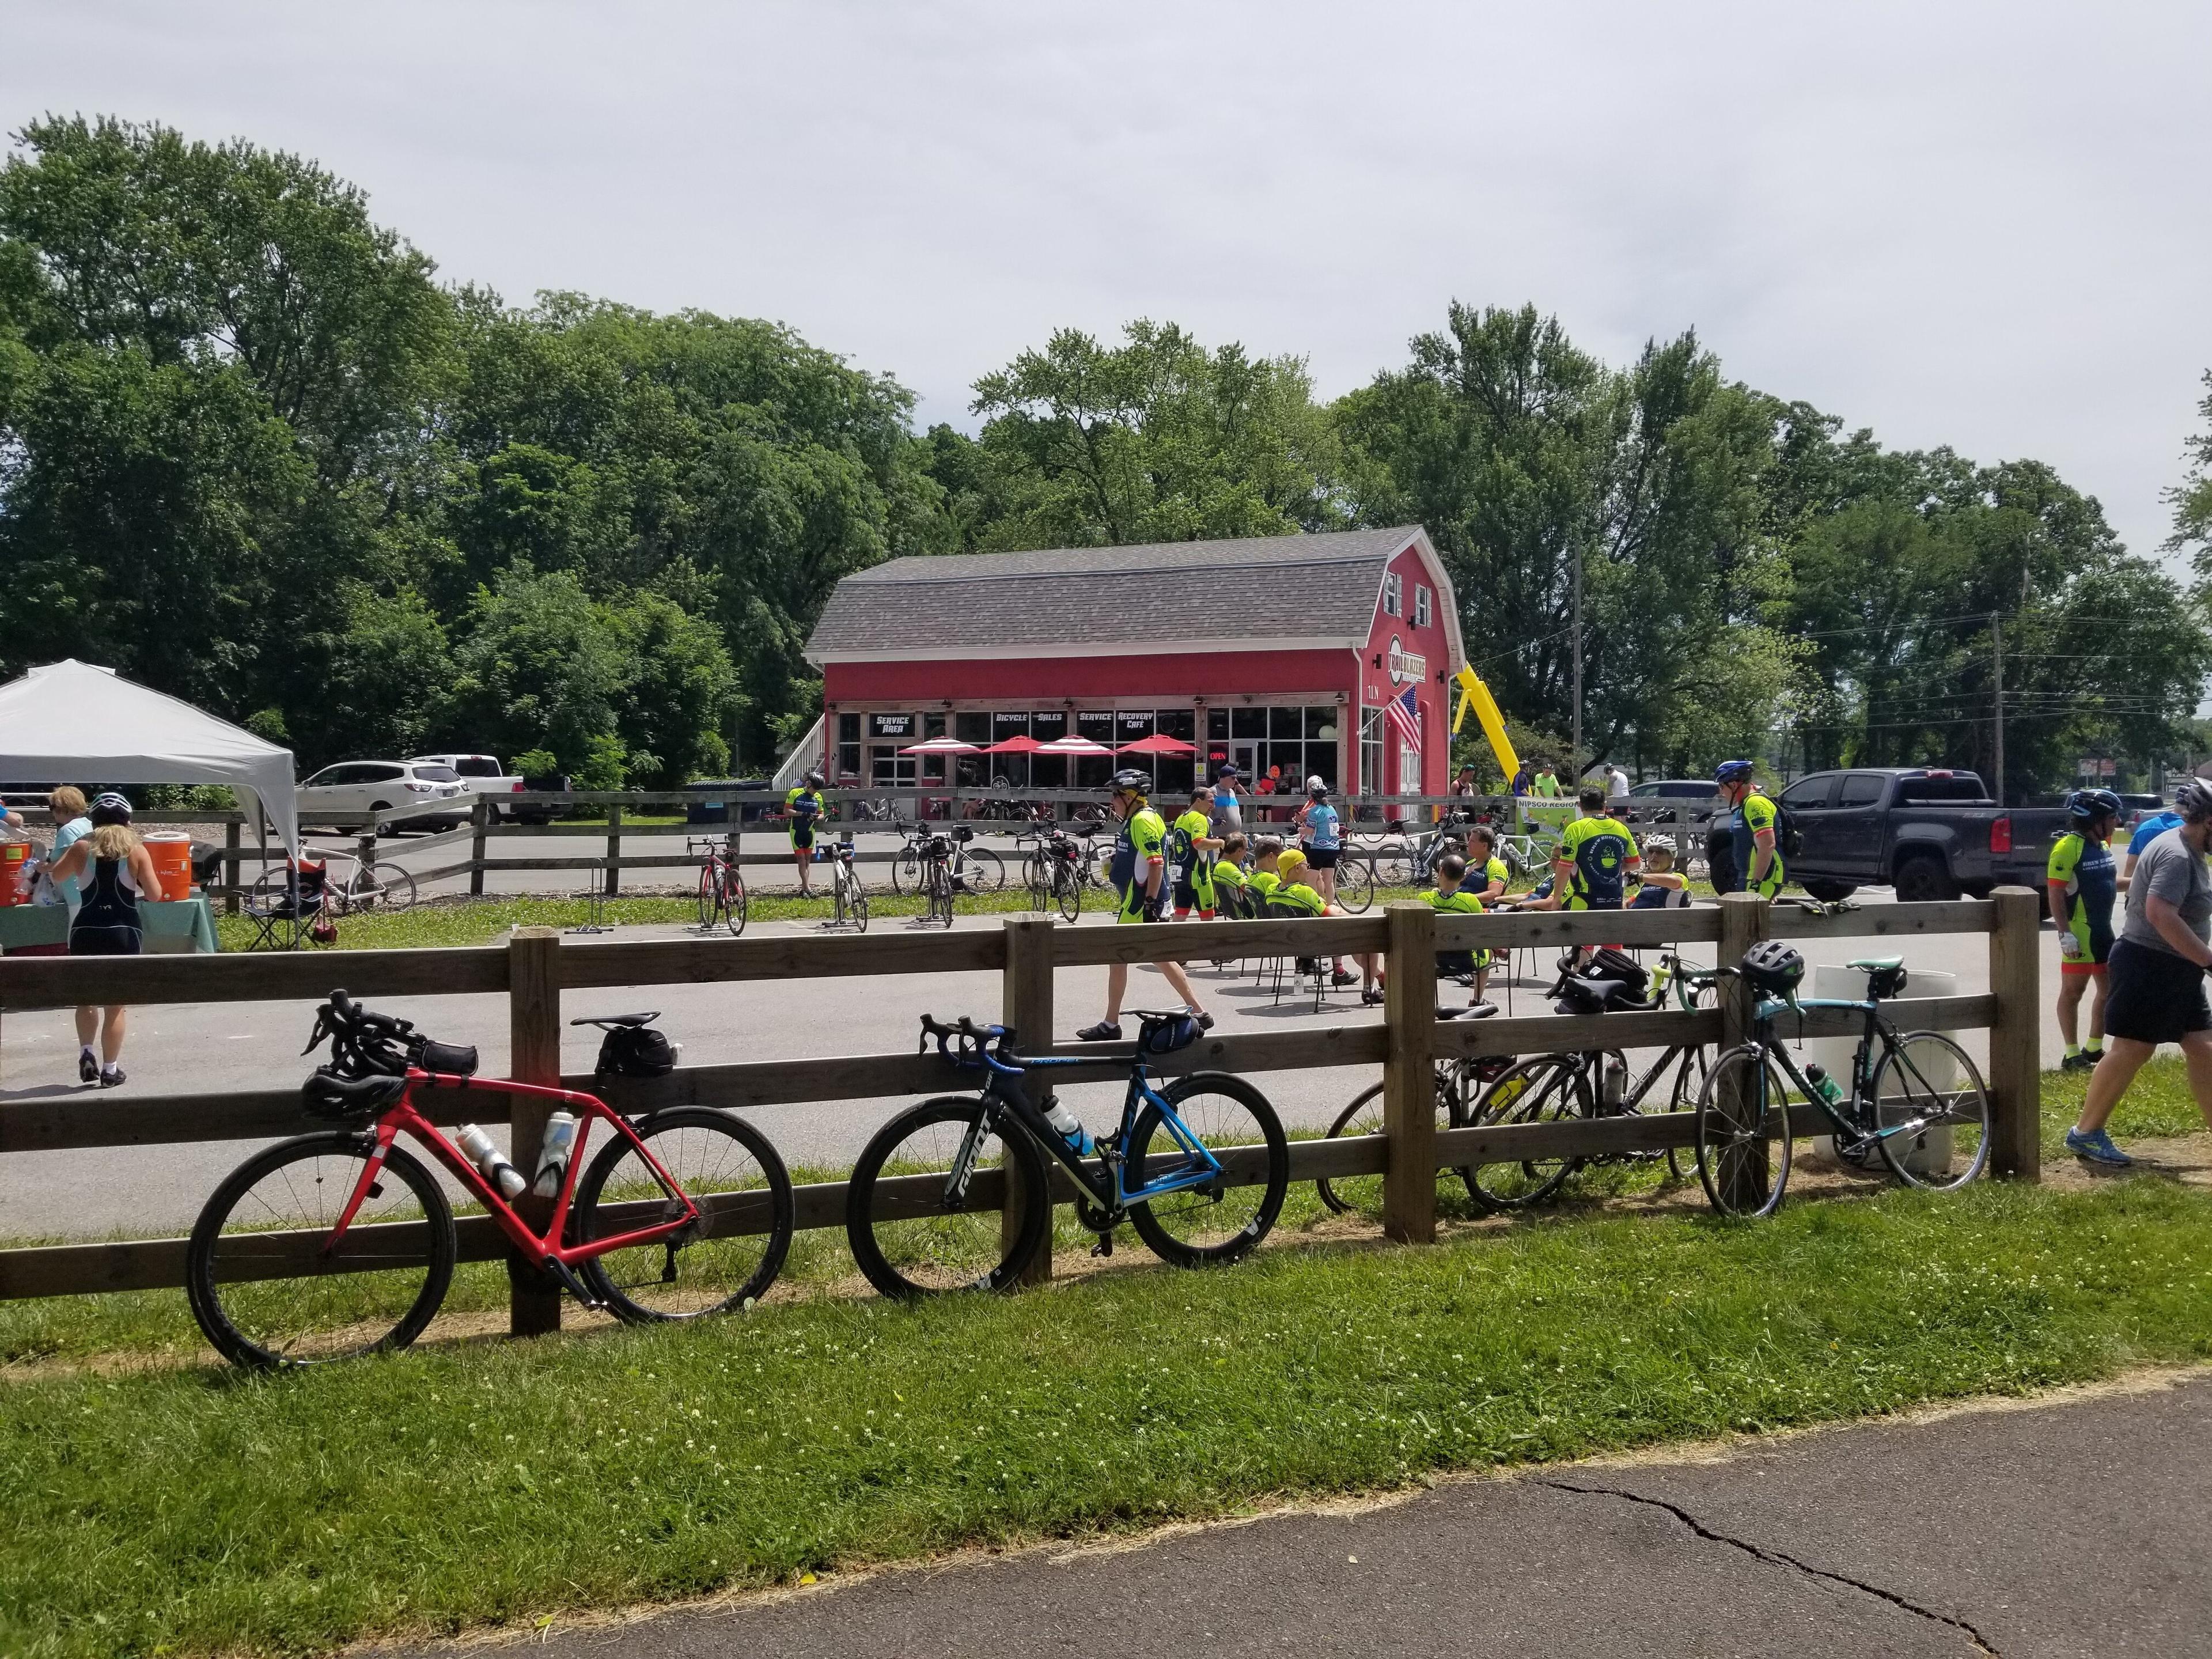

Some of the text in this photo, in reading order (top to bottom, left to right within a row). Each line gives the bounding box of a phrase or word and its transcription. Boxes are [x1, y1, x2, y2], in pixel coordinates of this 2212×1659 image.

[1389, 653, 1425, 677] TRAILBLAZERS
[877, 717, 909, 725] SERVICE
[882, 725, 903, 733] AREA
[957, 1108, 991, 1198] GIANT
